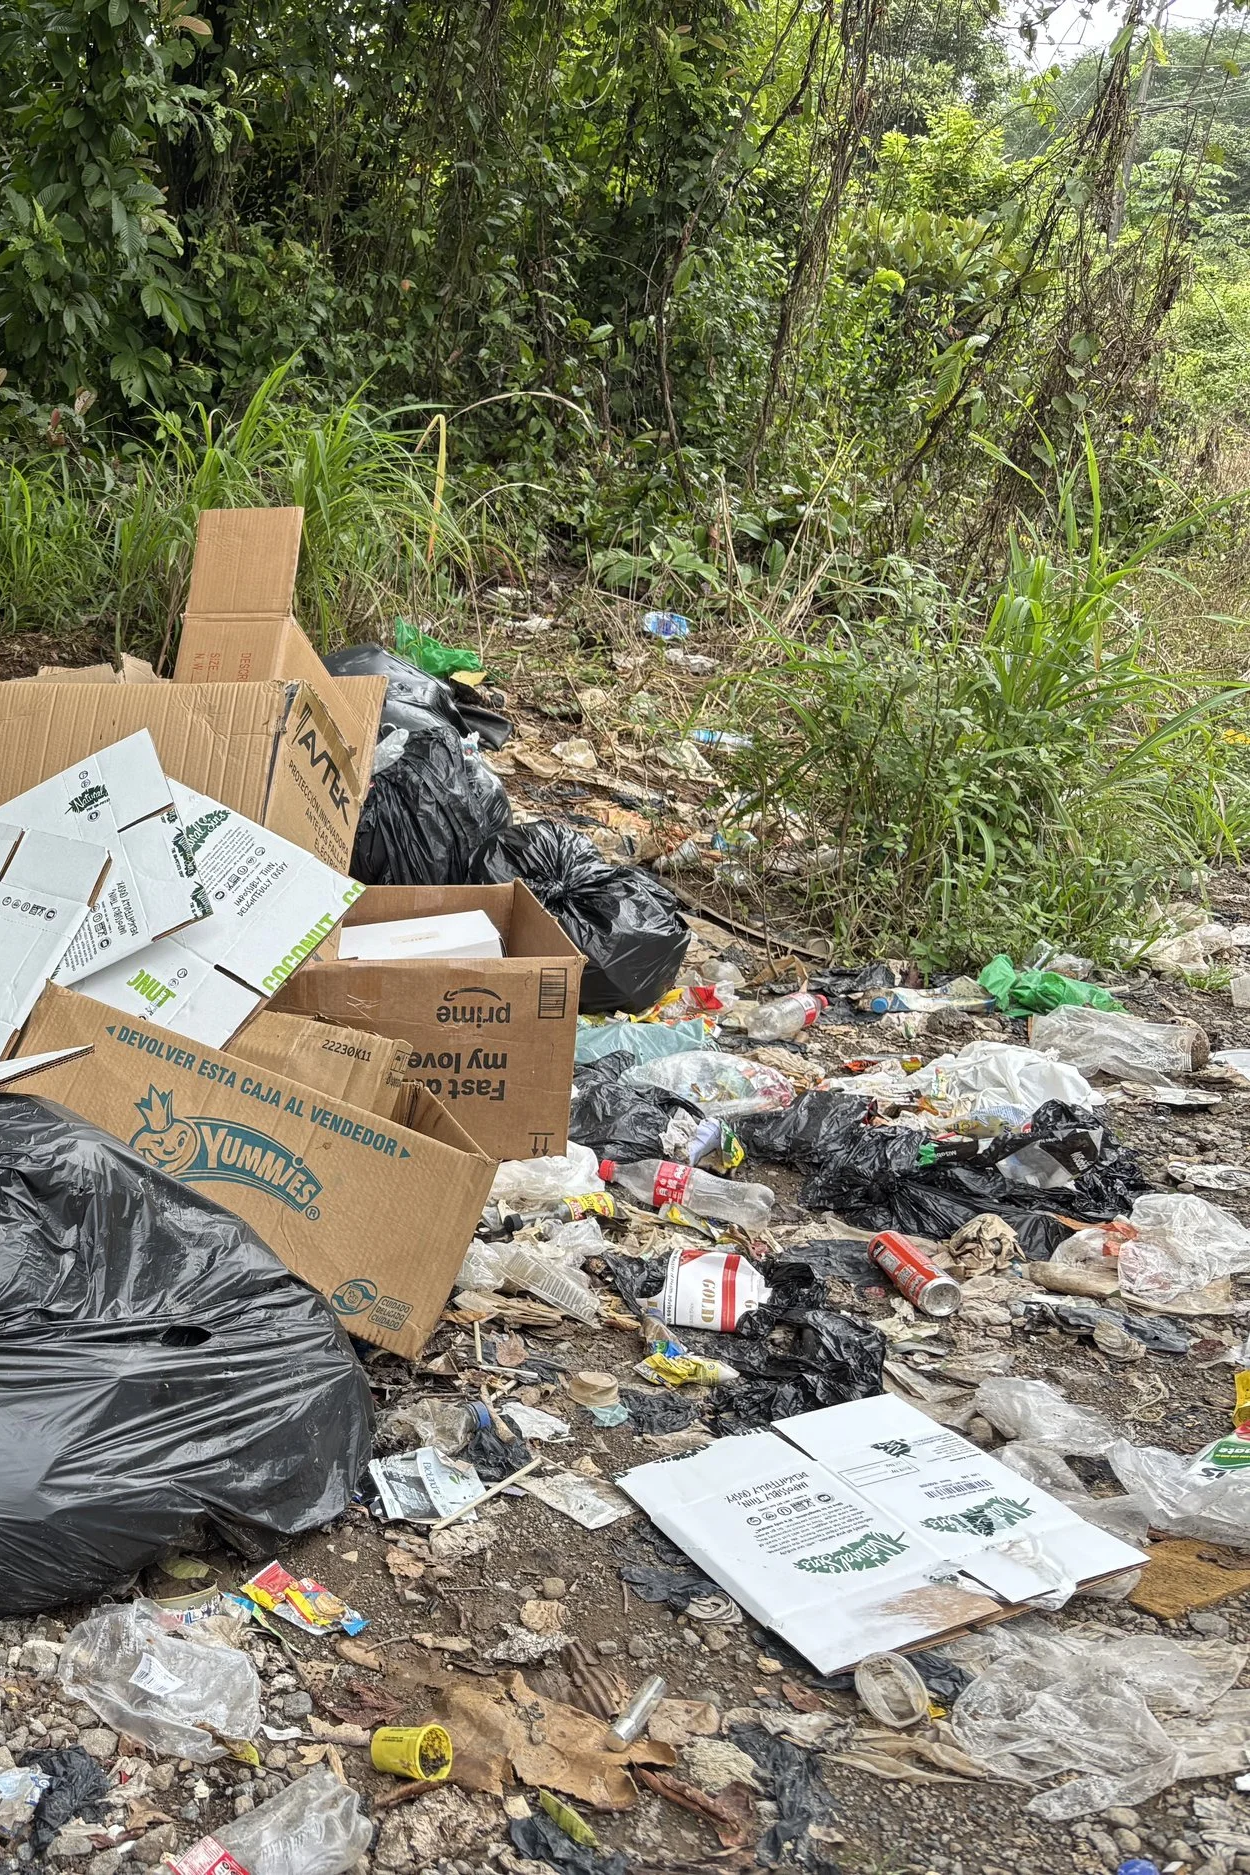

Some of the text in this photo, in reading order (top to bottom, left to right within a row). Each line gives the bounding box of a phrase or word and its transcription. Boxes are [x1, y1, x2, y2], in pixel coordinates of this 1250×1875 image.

[313, 838, 338, 870] ELÉCTRI
[261, 912, 336, 992] COCONUT
[436, 1002, 511, 1028] prime
[407, 1048, 508, 1074] my love
[116, 1025, 399, 1159] DEVOLVER ESTA CAJA AL VENDEDOR
[447, 1078, 506, 1101] Fast
[375, 1306, 405, 1321] DELICADO
[381, 1298, 411, 1314] CUIDADO
[701, 1278, 716, 1323] GOLD
[370, 1314, 400, 1329] CUIDADO
[752, 1471, 810, 1492] DELIGHTFULLY
[766, 1482, 810, 1501] IMPOSSIBLY
[800, 1536, 902, 1574] Natural Sins
